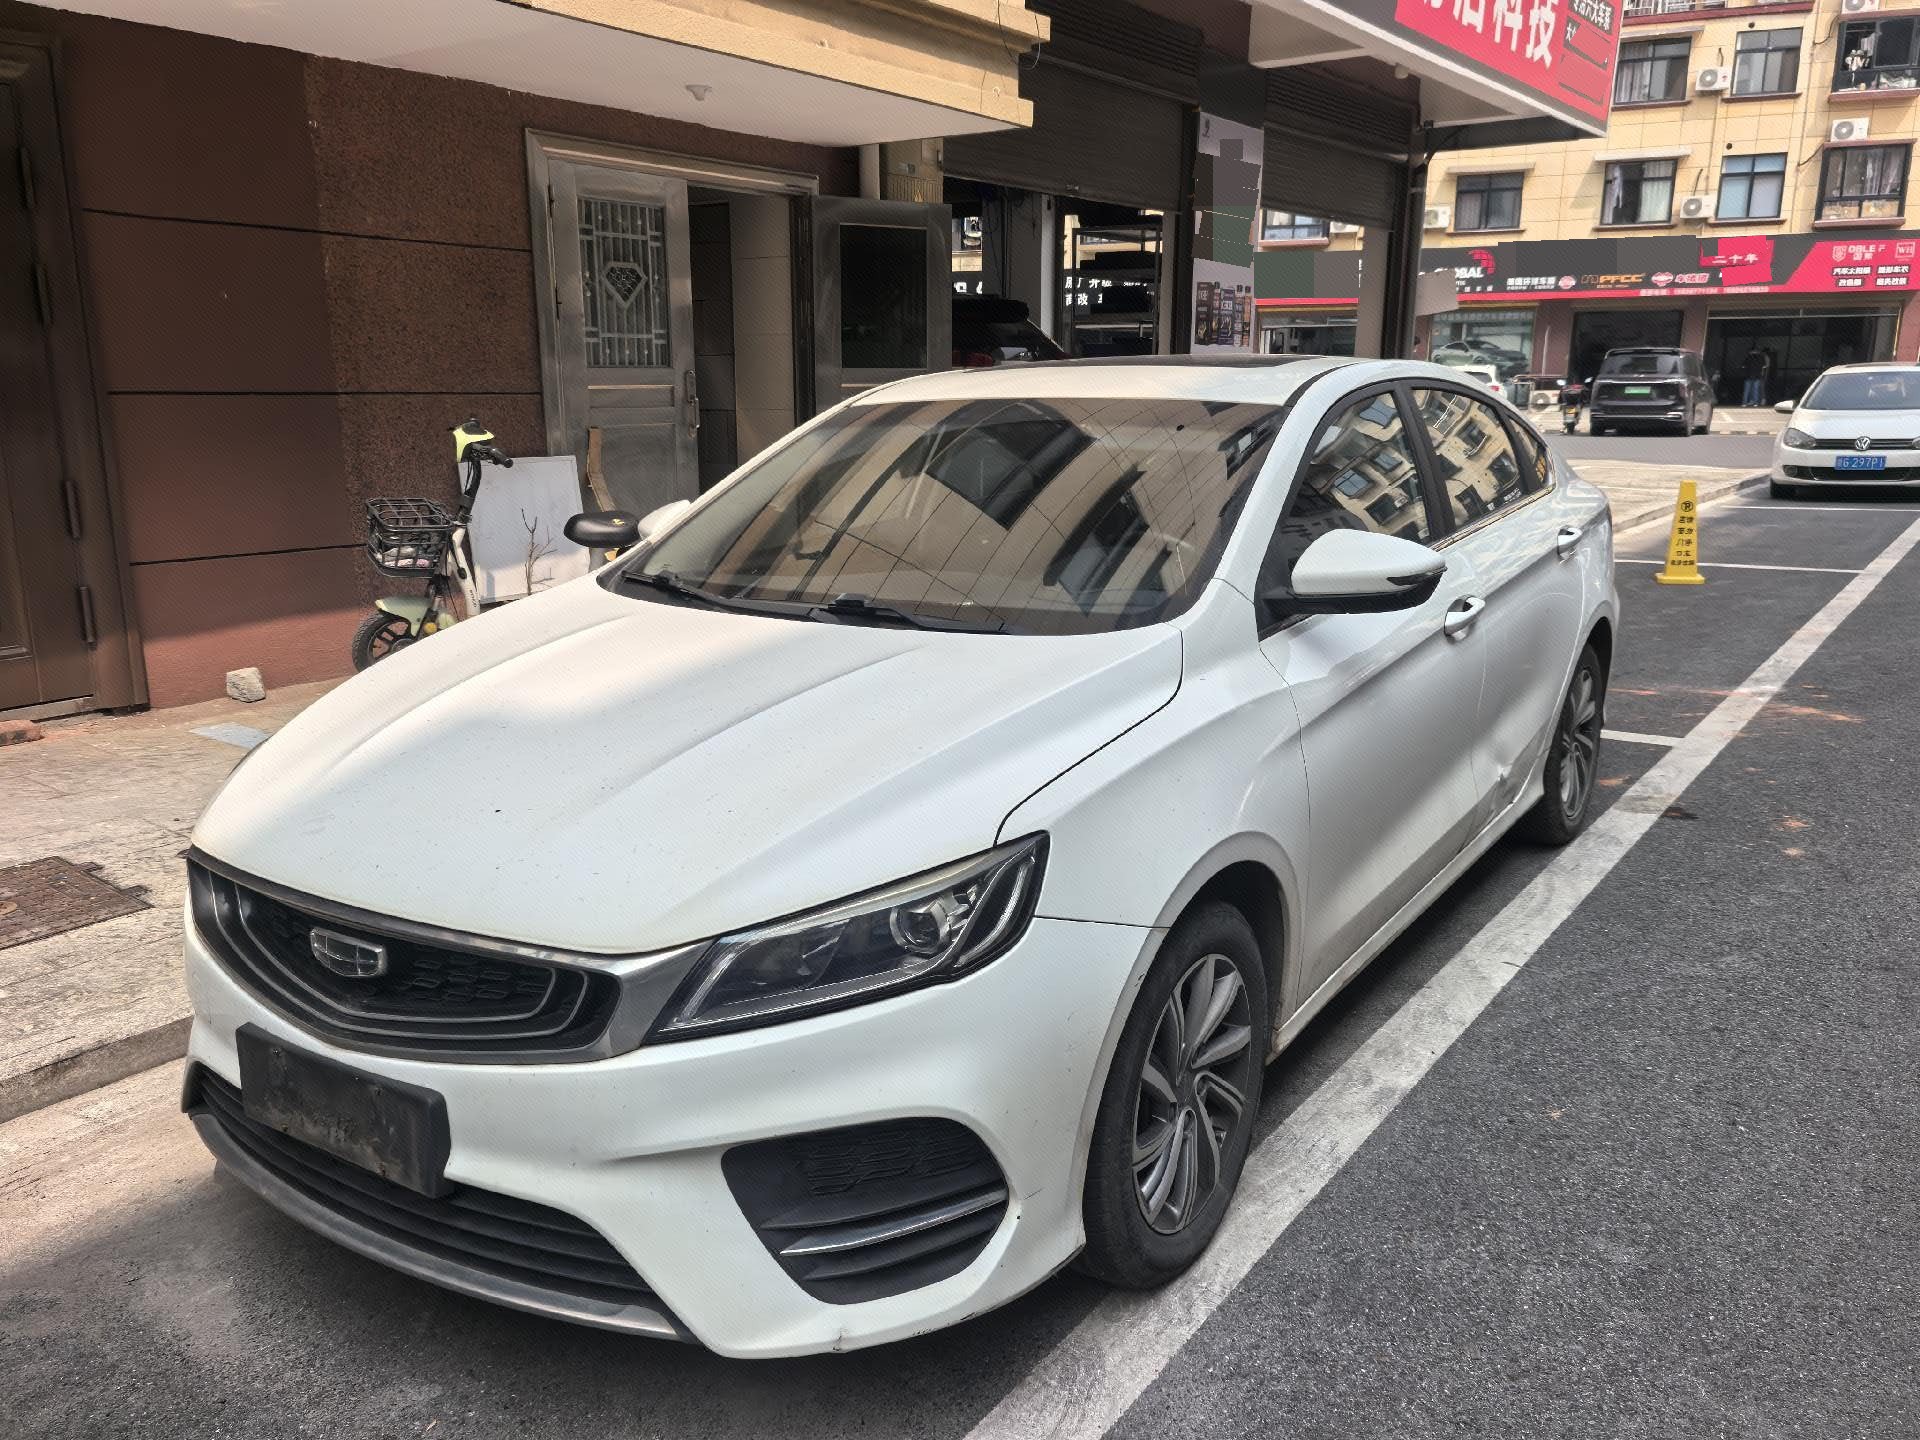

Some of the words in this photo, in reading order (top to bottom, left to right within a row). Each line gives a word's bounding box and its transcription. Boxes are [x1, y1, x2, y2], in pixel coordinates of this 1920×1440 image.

[1424, 0, 1556, 69] 科技
[1711, 252, 1759, 265] 二十年
